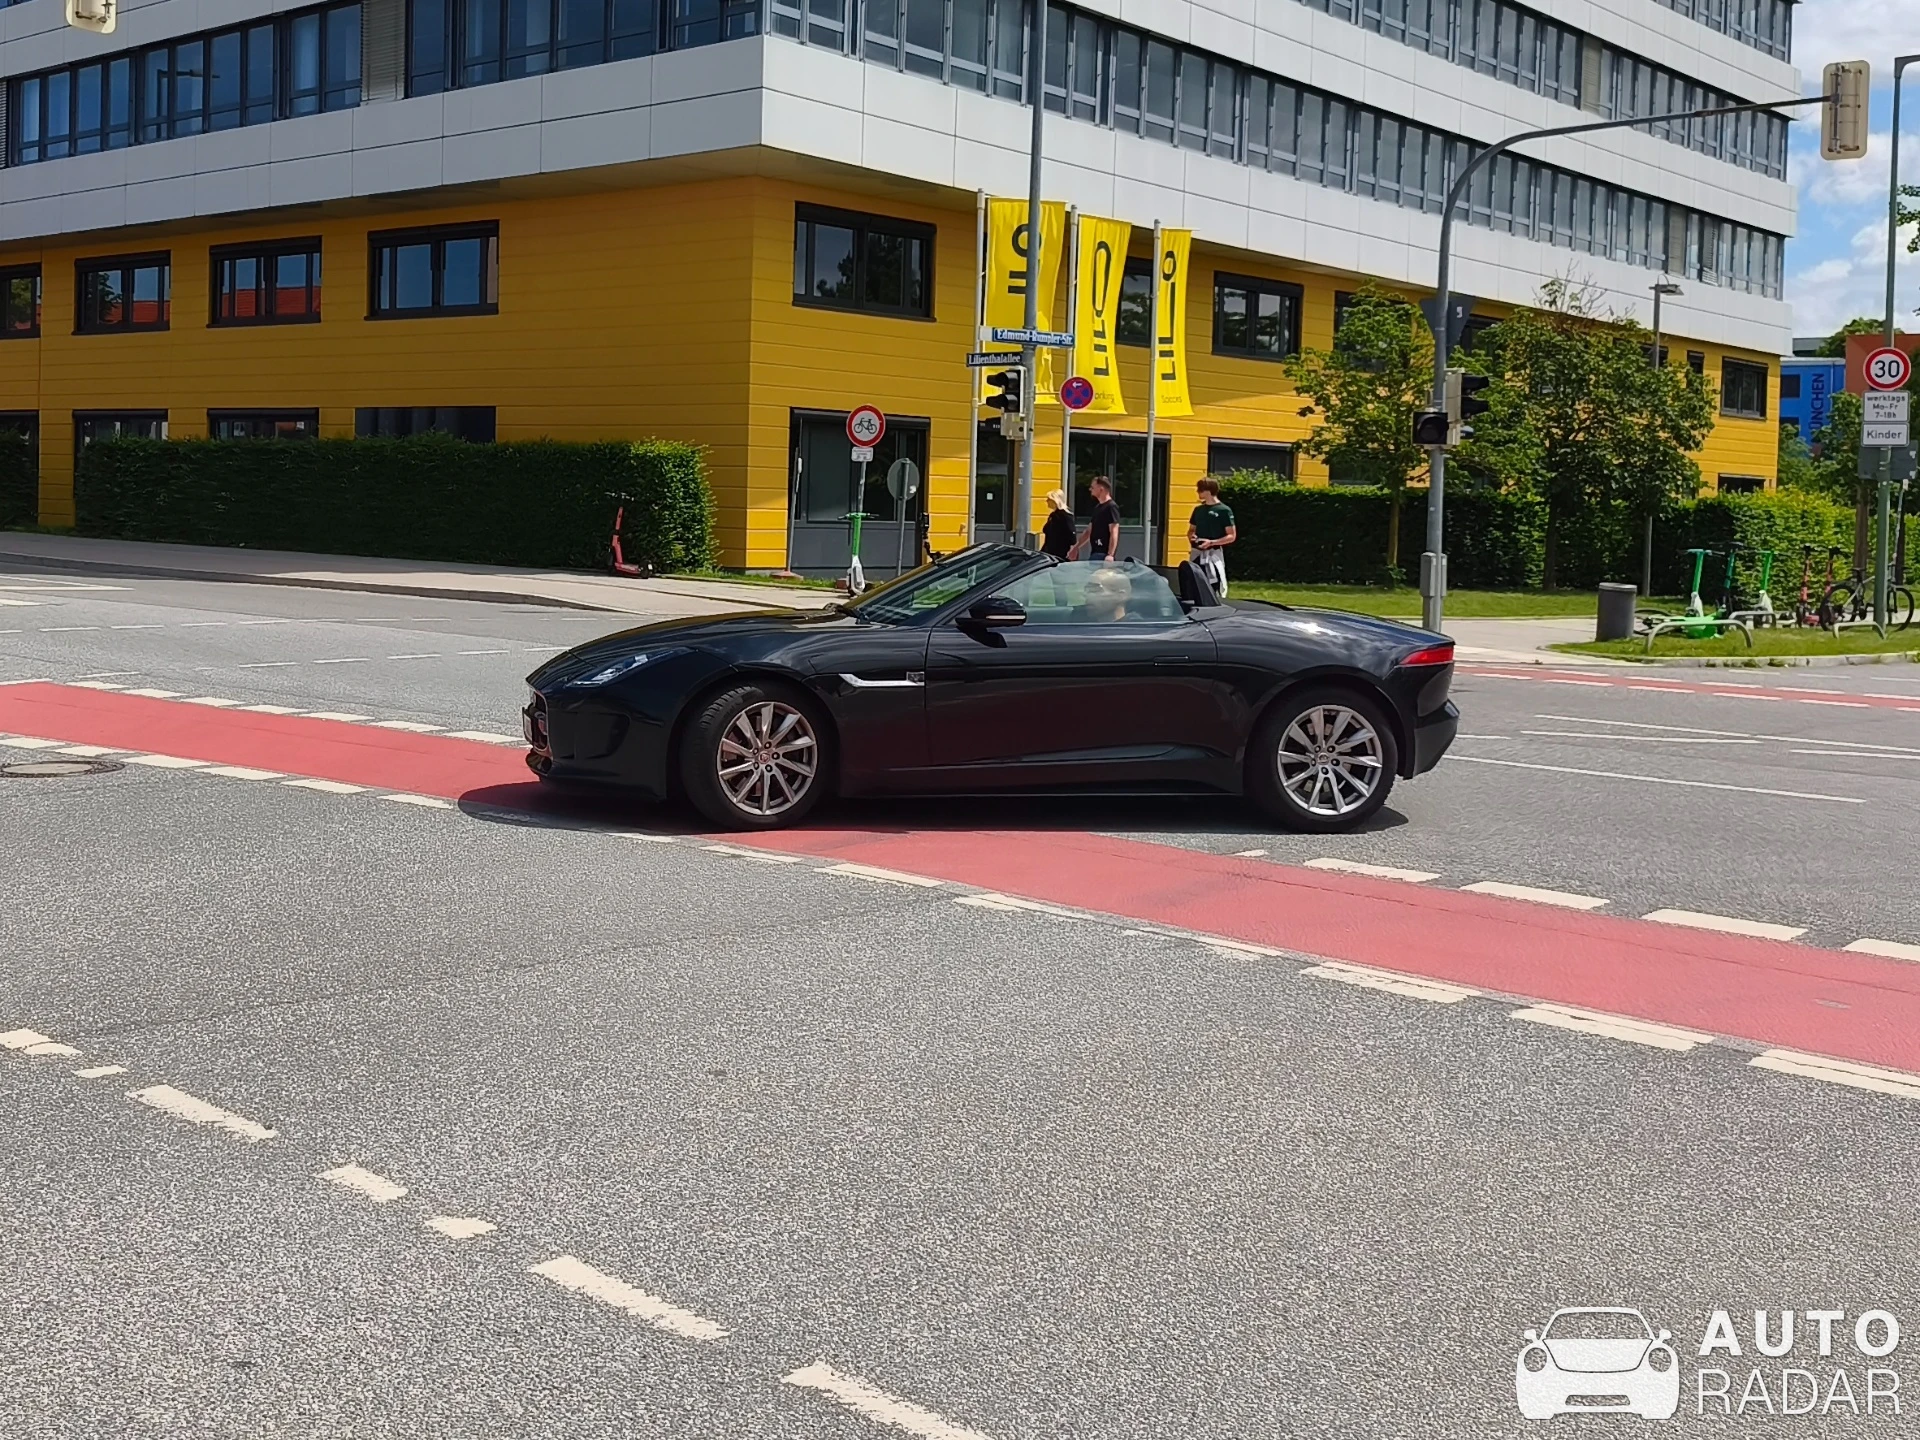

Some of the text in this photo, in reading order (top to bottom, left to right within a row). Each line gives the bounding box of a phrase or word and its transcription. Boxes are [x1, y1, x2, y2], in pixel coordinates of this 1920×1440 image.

[997, 329, 1073, 345] Edmund-Rumpler-Str.
[968, 353, 1020, 365] Lilienthalallee
[1874, 360, 1900, 378] 30
[1866, 395, 1906, 403] werktags
[1808, 373, 1825, 442] ÜNCHEN
[1873, 403, 1898, 411] Mo-Fr
[1867, 430, 1902, 439] Kinder
